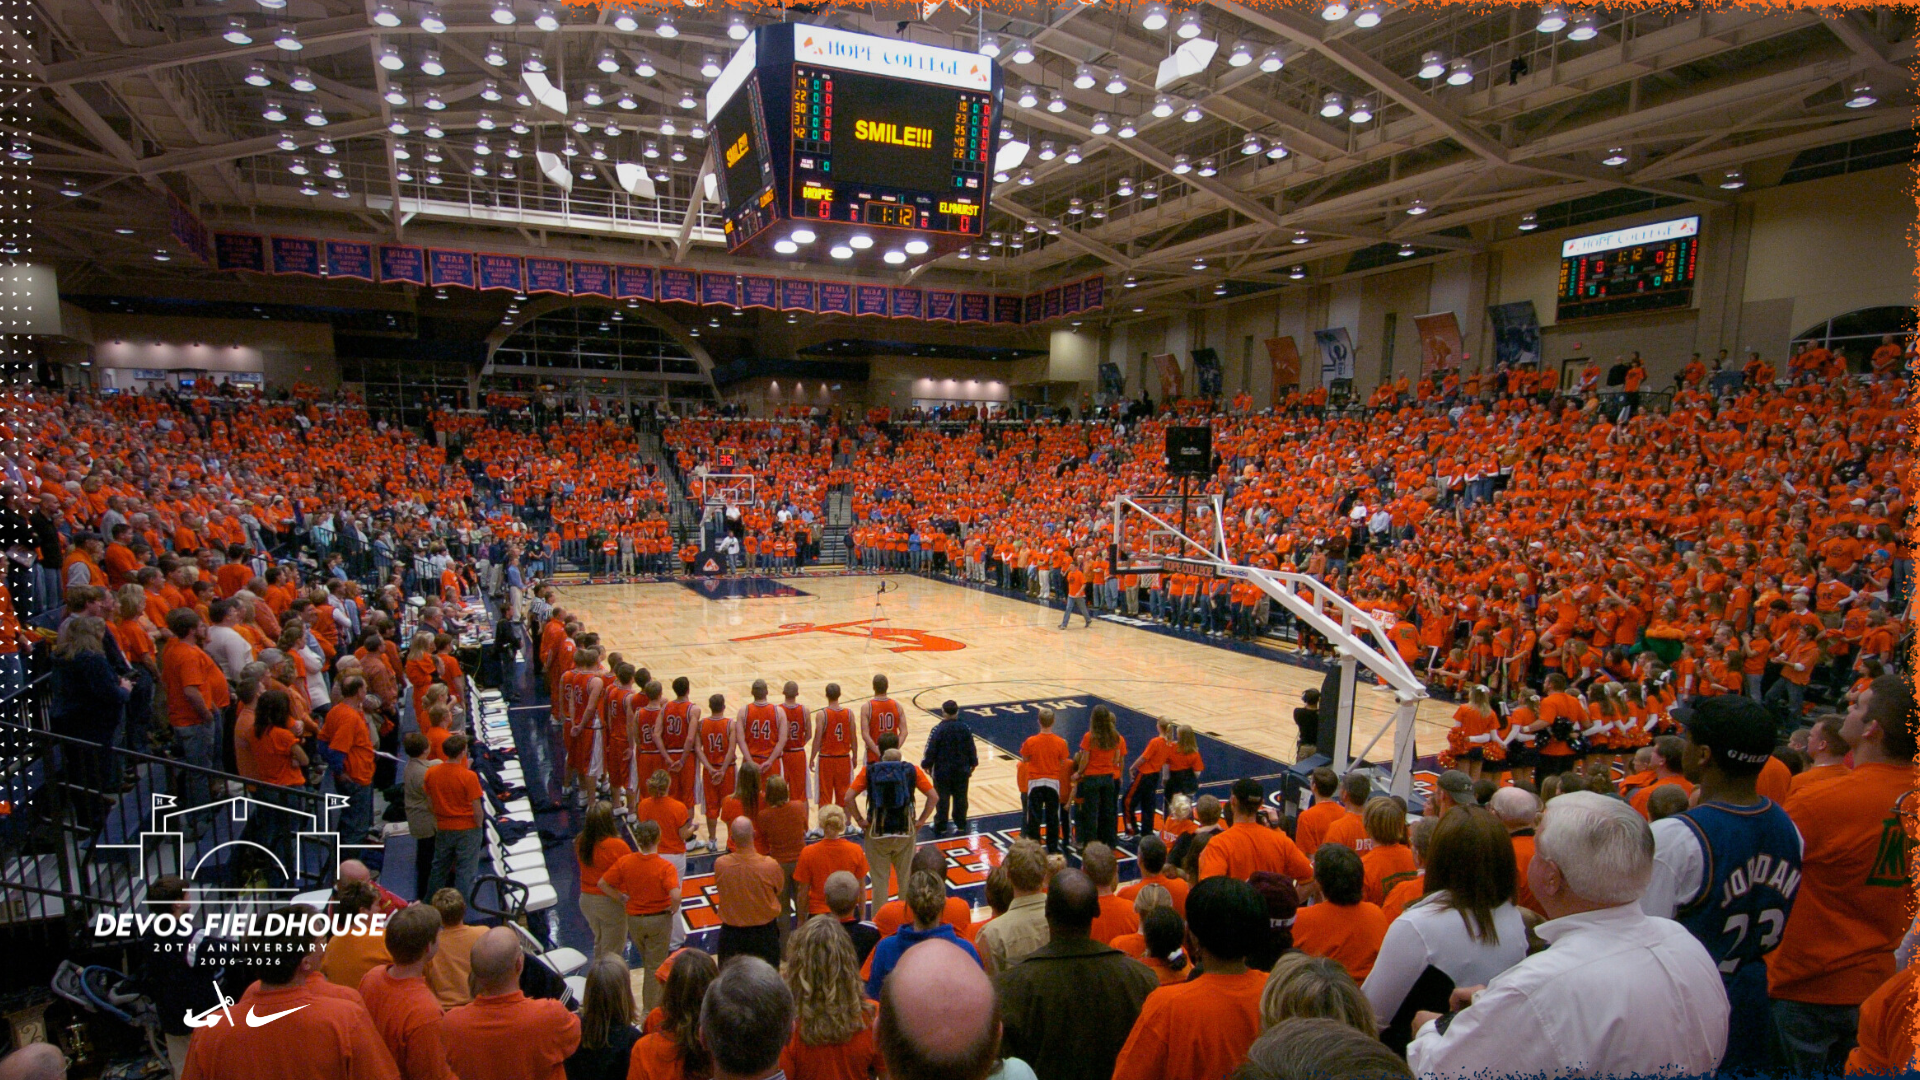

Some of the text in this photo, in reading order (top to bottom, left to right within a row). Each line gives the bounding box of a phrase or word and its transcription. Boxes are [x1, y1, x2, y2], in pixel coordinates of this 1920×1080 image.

[828, 41, 958, 75] HOPE COLLEGE
[855, 119, 933, 148] SMILE!!!
[803, 186, 834, 201] HOPE
[819, 200, 830, 219] 0
[882, 207, 912, 226] 1:12
[939, 202, 980, 216] ELMHURST
[960, 214, 970, 232] 0
[963, 699, 1088, 717] MIAA
[666, 714, 682, 736] 30
[751, 719, 771, 740] 44
[878, 712, 894, 731] 10
[835, 723, 843, 741] 4
[707, 732, 723, 753] 14
[1721, 854, 1802, 909] JORDAN
[1717, 908, 1785, 973] 23
